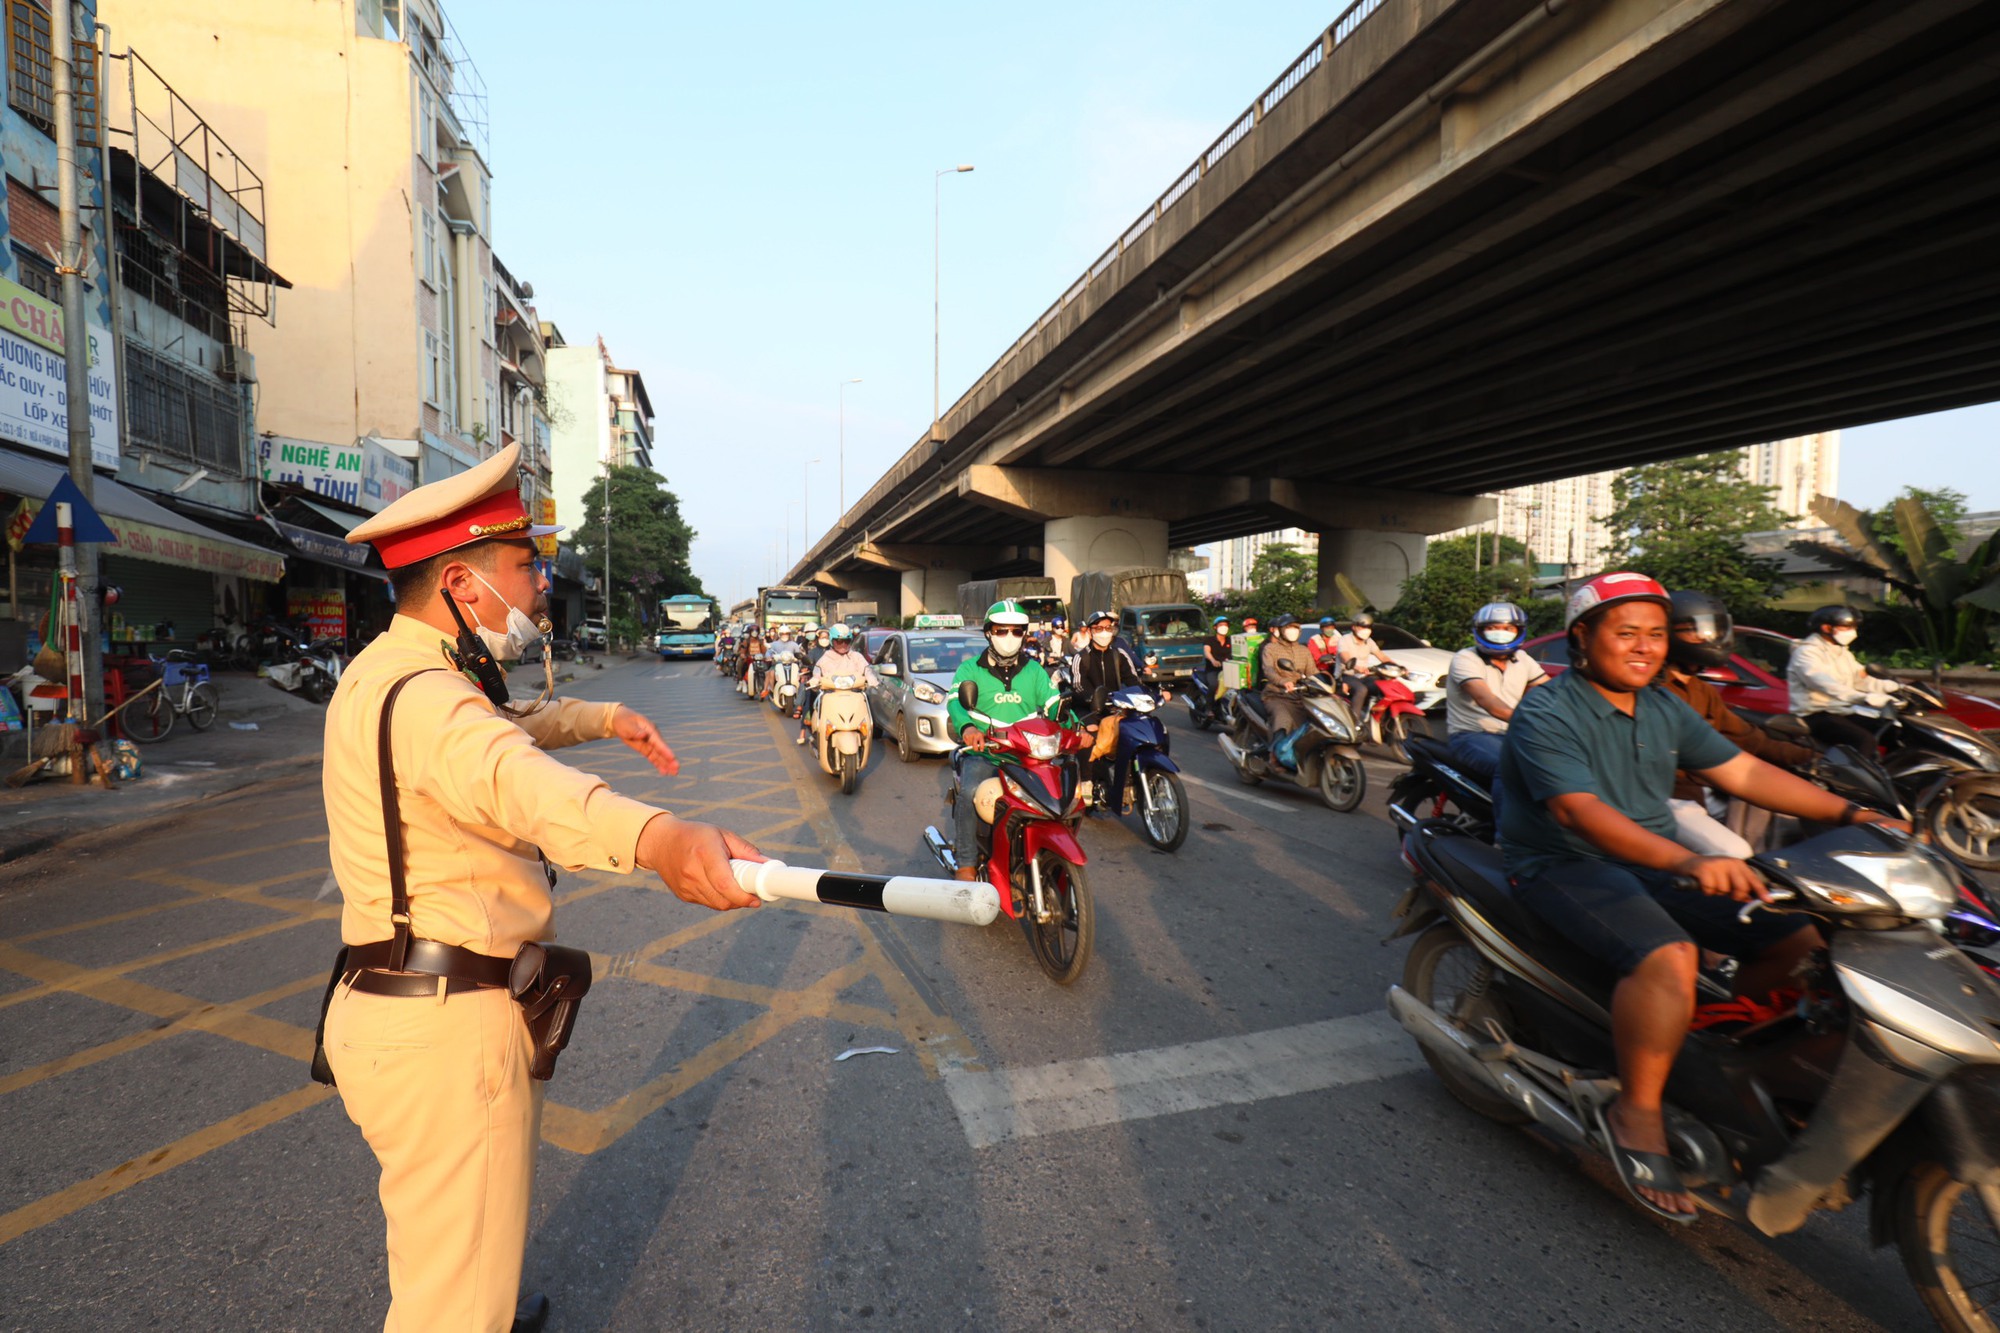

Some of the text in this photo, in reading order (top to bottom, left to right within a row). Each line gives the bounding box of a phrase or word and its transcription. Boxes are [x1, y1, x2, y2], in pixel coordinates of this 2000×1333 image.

[20, 376, 45, 398] QUY
[88, 376, 111, 400] HÚY
[24, 401, 48, 422] LỐP
[51, 411, 68, 430] XE
[281, 443, 330, 471] NGHỆ
[335, 451, 361, 472] AN
[313, 474, 359, 506] TĨNH
[994, 692, 1022, 704] Grab
